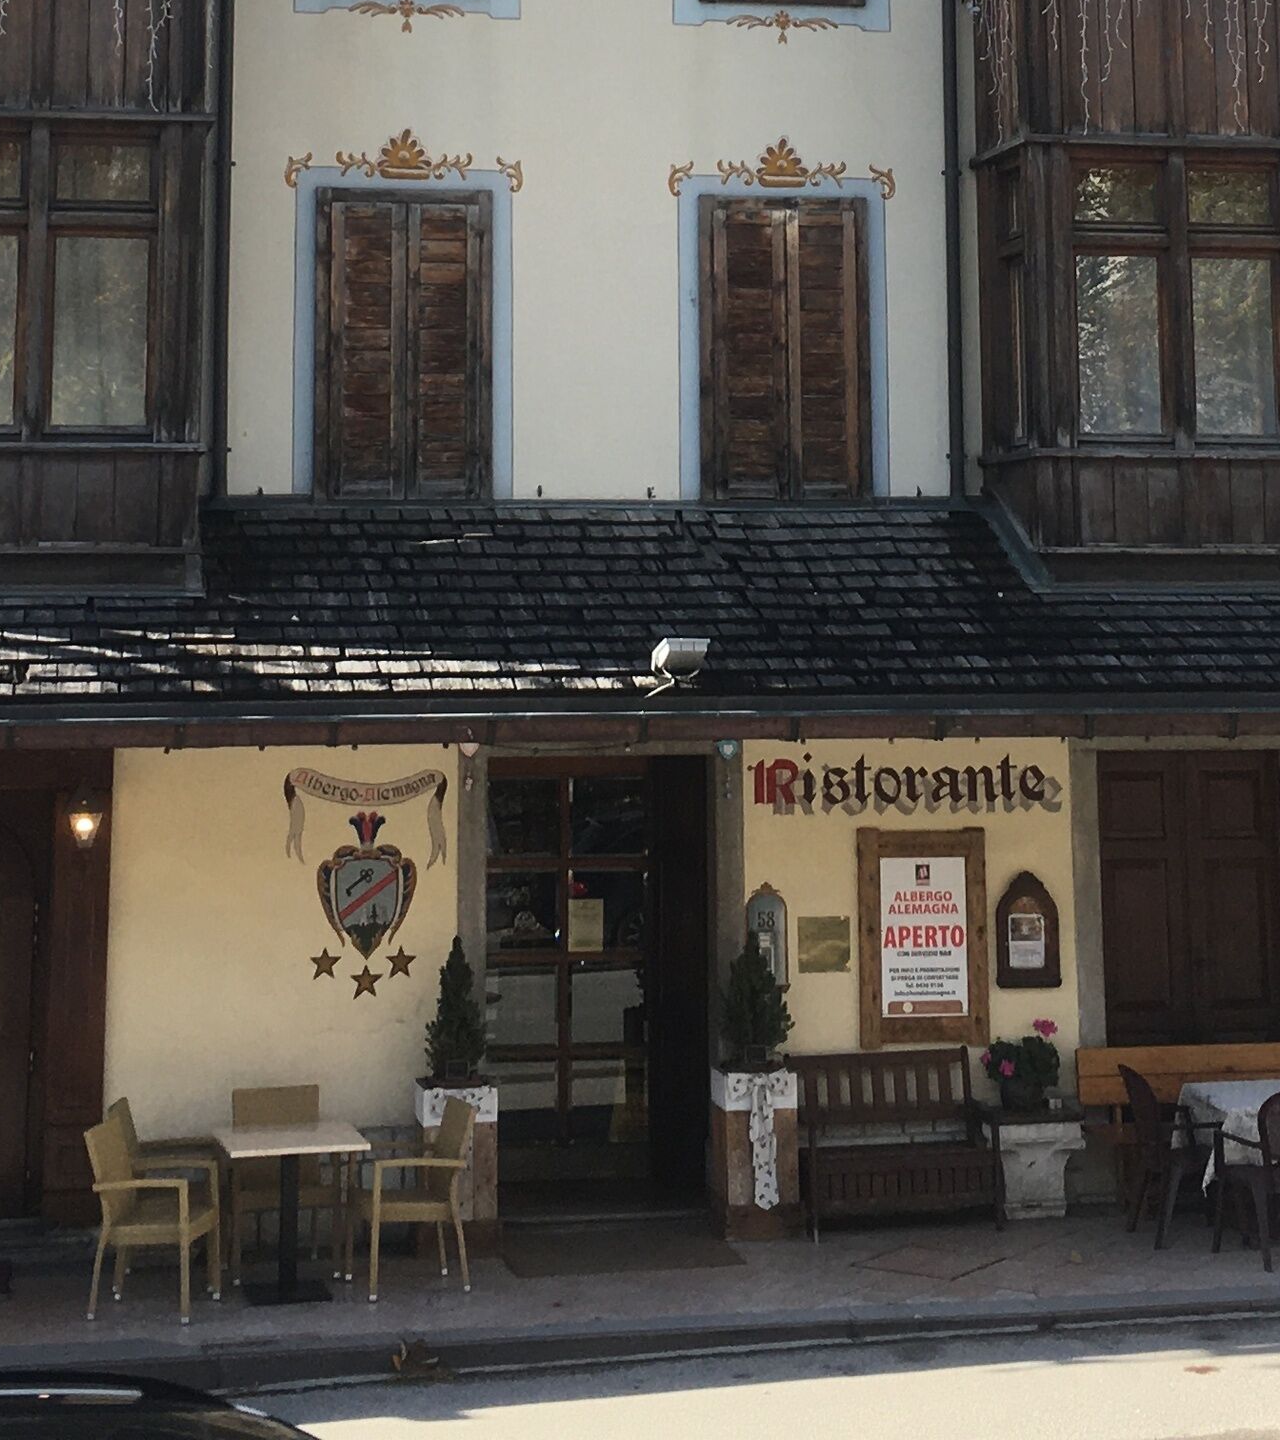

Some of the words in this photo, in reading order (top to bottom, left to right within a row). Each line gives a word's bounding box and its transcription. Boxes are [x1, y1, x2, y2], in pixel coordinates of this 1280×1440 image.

[747, 752, 1047, 805] Ristorante
[894, 890, 953, 902] ALBERGO
[888, 903, 959, 915] ALEMAGNA
[757, 910, 776, 929] 58
[883, 925, 965, 949] APERTO
